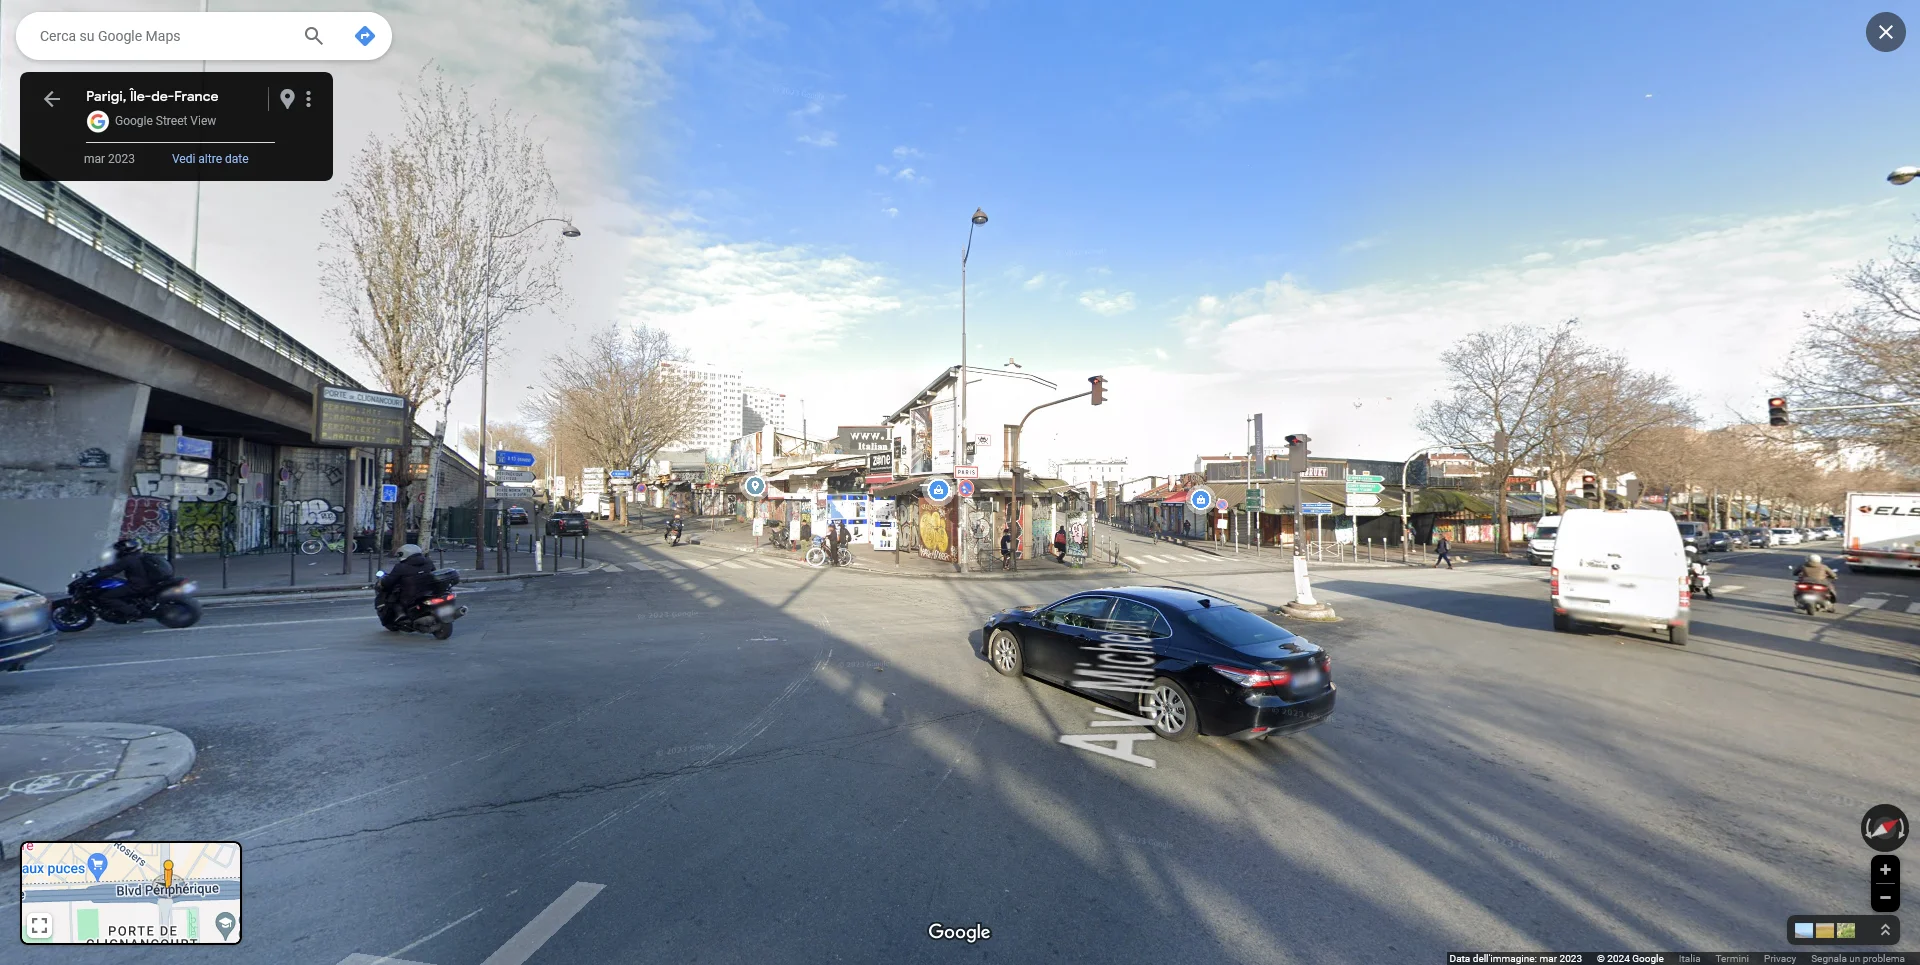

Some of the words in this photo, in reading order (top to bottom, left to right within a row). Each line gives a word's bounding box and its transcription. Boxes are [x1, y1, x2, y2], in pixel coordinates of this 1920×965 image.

[323, 388, 347, 400] PORTE
[357, 394, 404, 408] CLIGNANCOURT
[858, 442, 888, 451] Italian
